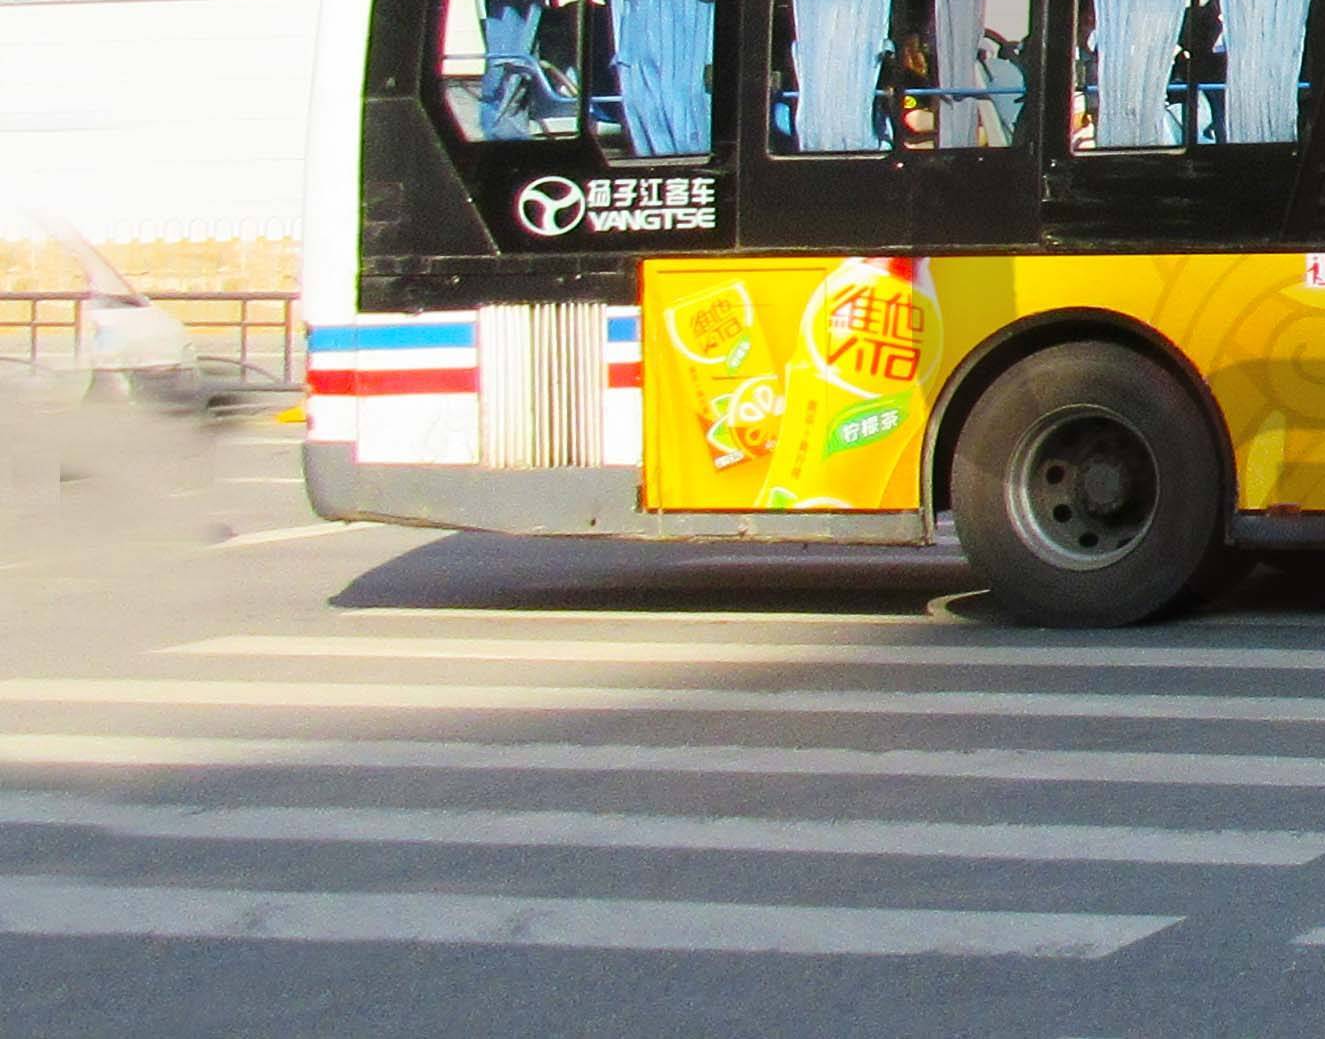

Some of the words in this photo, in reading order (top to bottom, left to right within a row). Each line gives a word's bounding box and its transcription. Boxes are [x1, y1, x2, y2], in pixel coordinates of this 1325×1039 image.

[587, 178, 716, 207] 扬子江客车
[588, 207, 716, 232] YANGTSE
[839, 409, 900, 444] 柠檬茶
